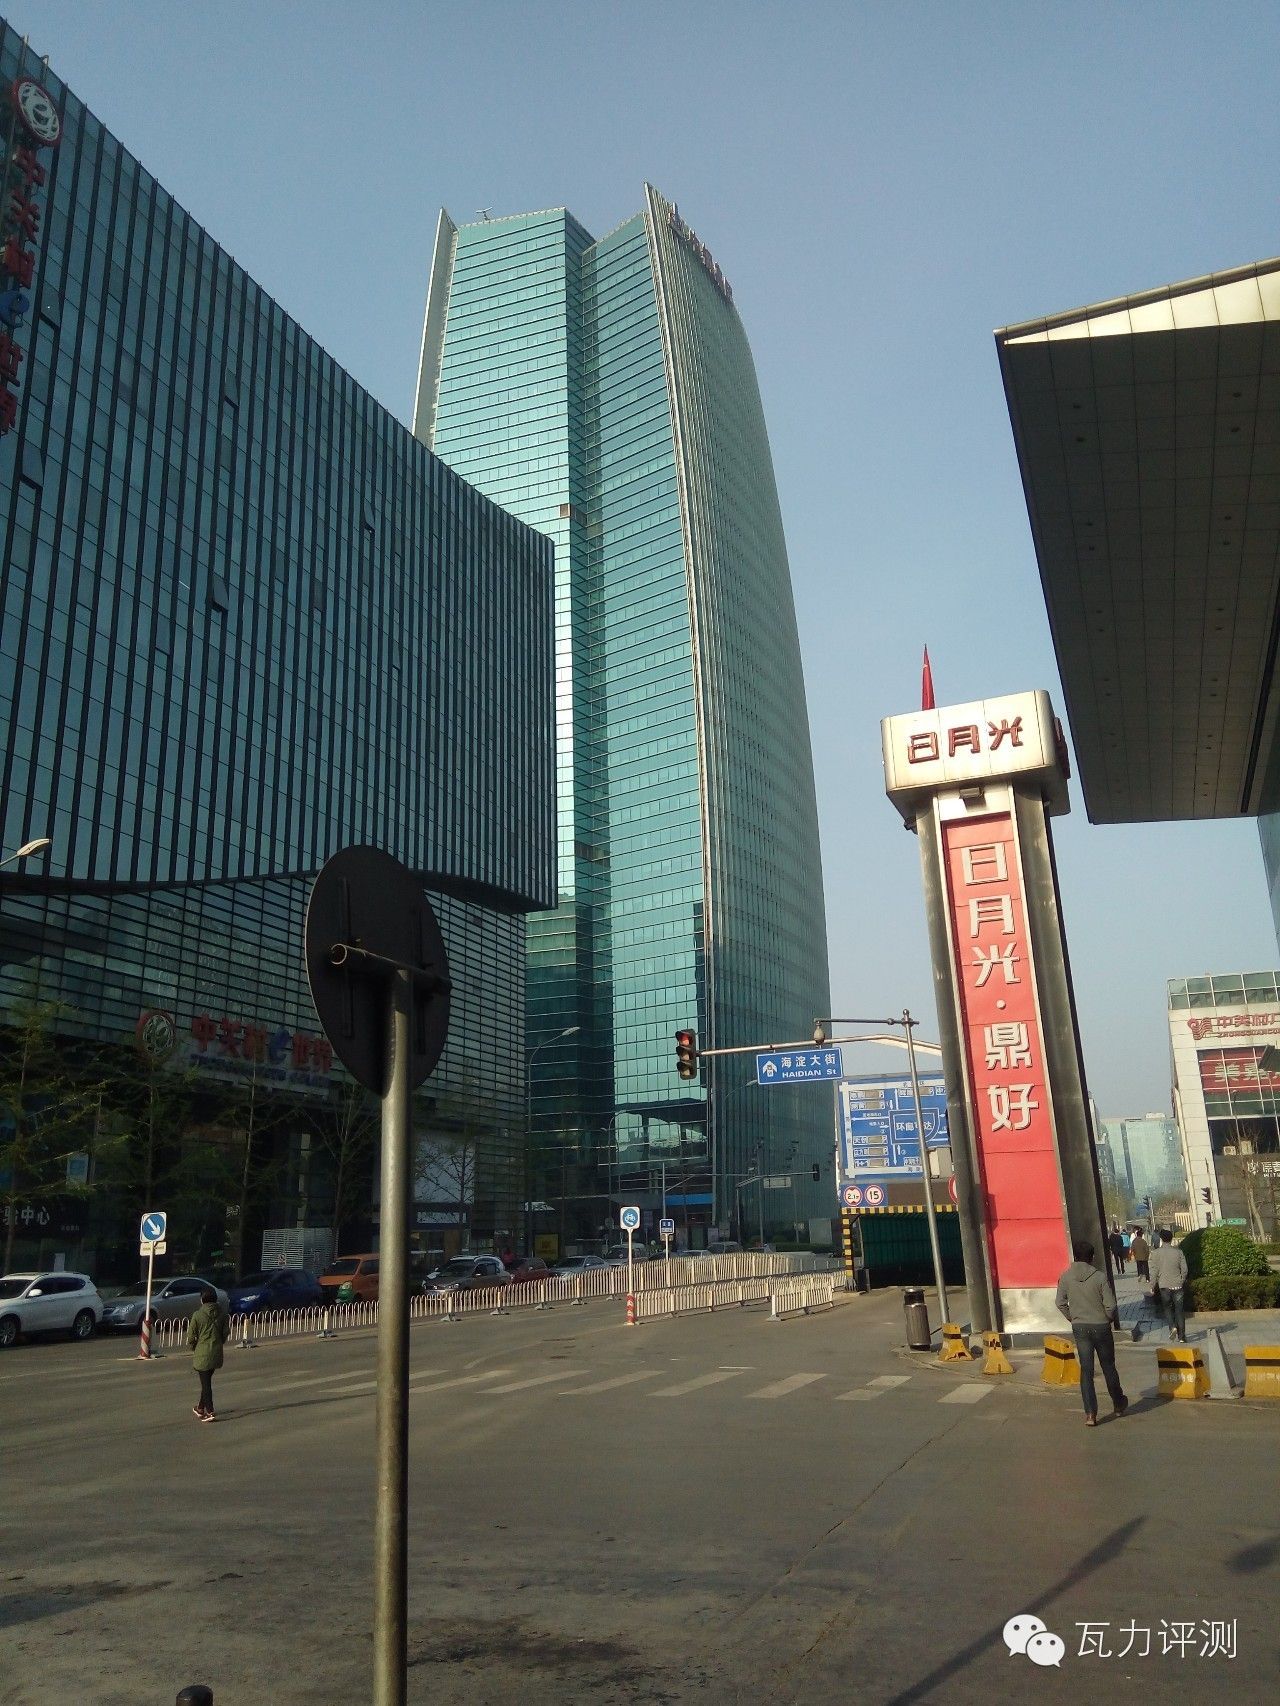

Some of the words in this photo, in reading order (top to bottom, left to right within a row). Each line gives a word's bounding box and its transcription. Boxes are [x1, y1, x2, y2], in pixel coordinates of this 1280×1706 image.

[907, 716, 1024, 764] 日月光
[781, 1053, 836, 1069] 海淀大街
[782, 1069, 822, 1078] HAIDIAN
[869, 1191, 880, 1200] 15
